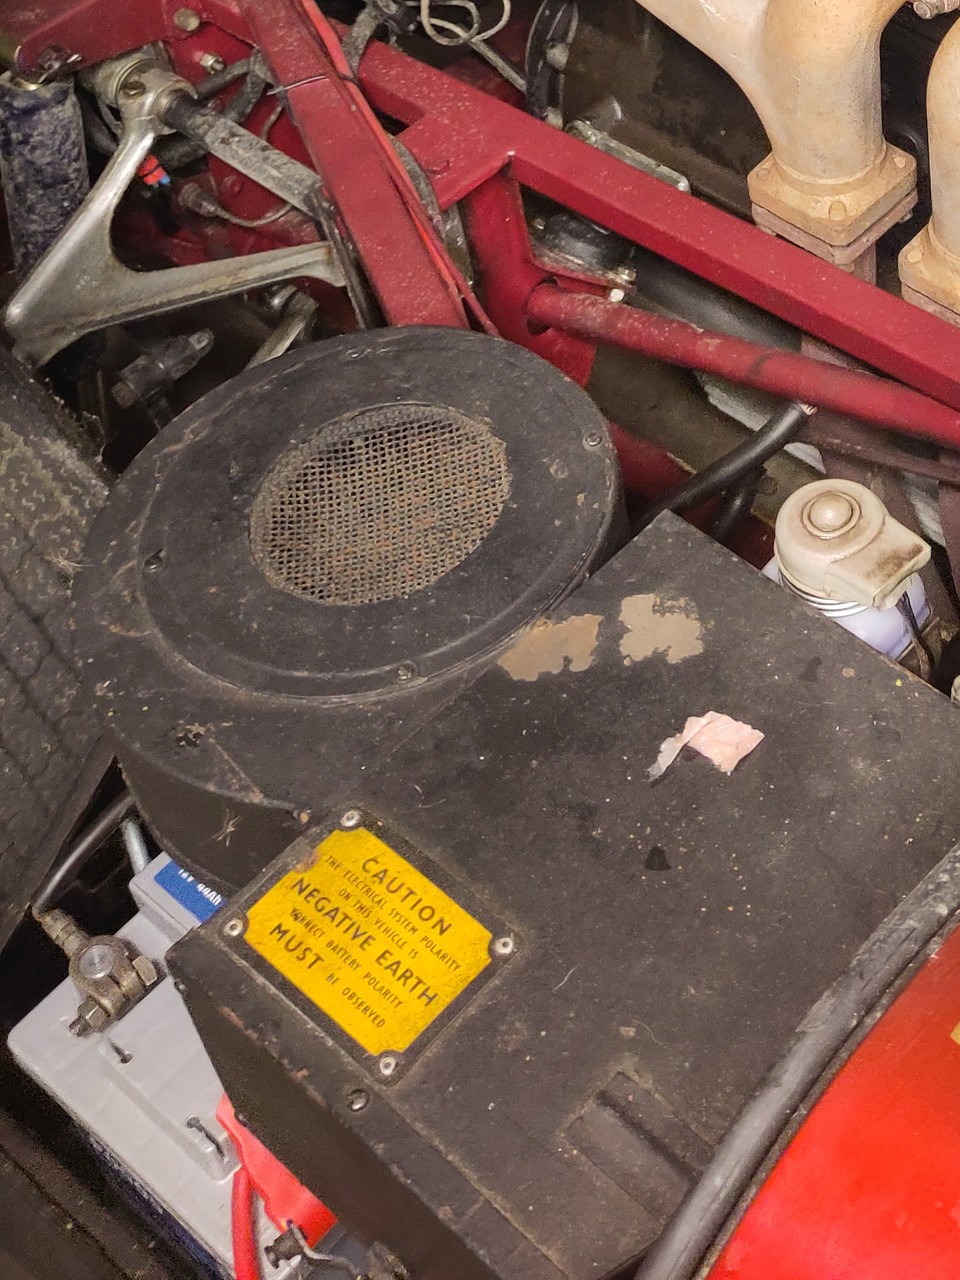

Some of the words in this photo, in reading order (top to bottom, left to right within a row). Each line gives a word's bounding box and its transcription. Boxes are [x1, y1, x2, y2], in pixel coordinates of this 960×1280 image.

[289, 877, 376, 951] NEGATIVE
[375, 949, 439, 1007] EARTH
[324, 855, 341, 871] THE
[343, 870, 387, 910] ELECTRICAL
[388, 907, 418, 935] SYSTEM
[419, 935, 461, 972] POLARITY
[338, 888, 353, 901] ON
[353, 899, 372, 919] THIS
[374, 917, 407, 949] VEHICLE
[408, 947, 418, 959] IS
[361, 856, 452, 936] CAUTION
[268, 922, 325, 969] MUST
[326, 973, 339, 985] BE
[341, 987, 385, 1028] OBSERVED
[325, 939, 361, 972] BATTERY
[362, 971, 403, 1009] POLARITY
